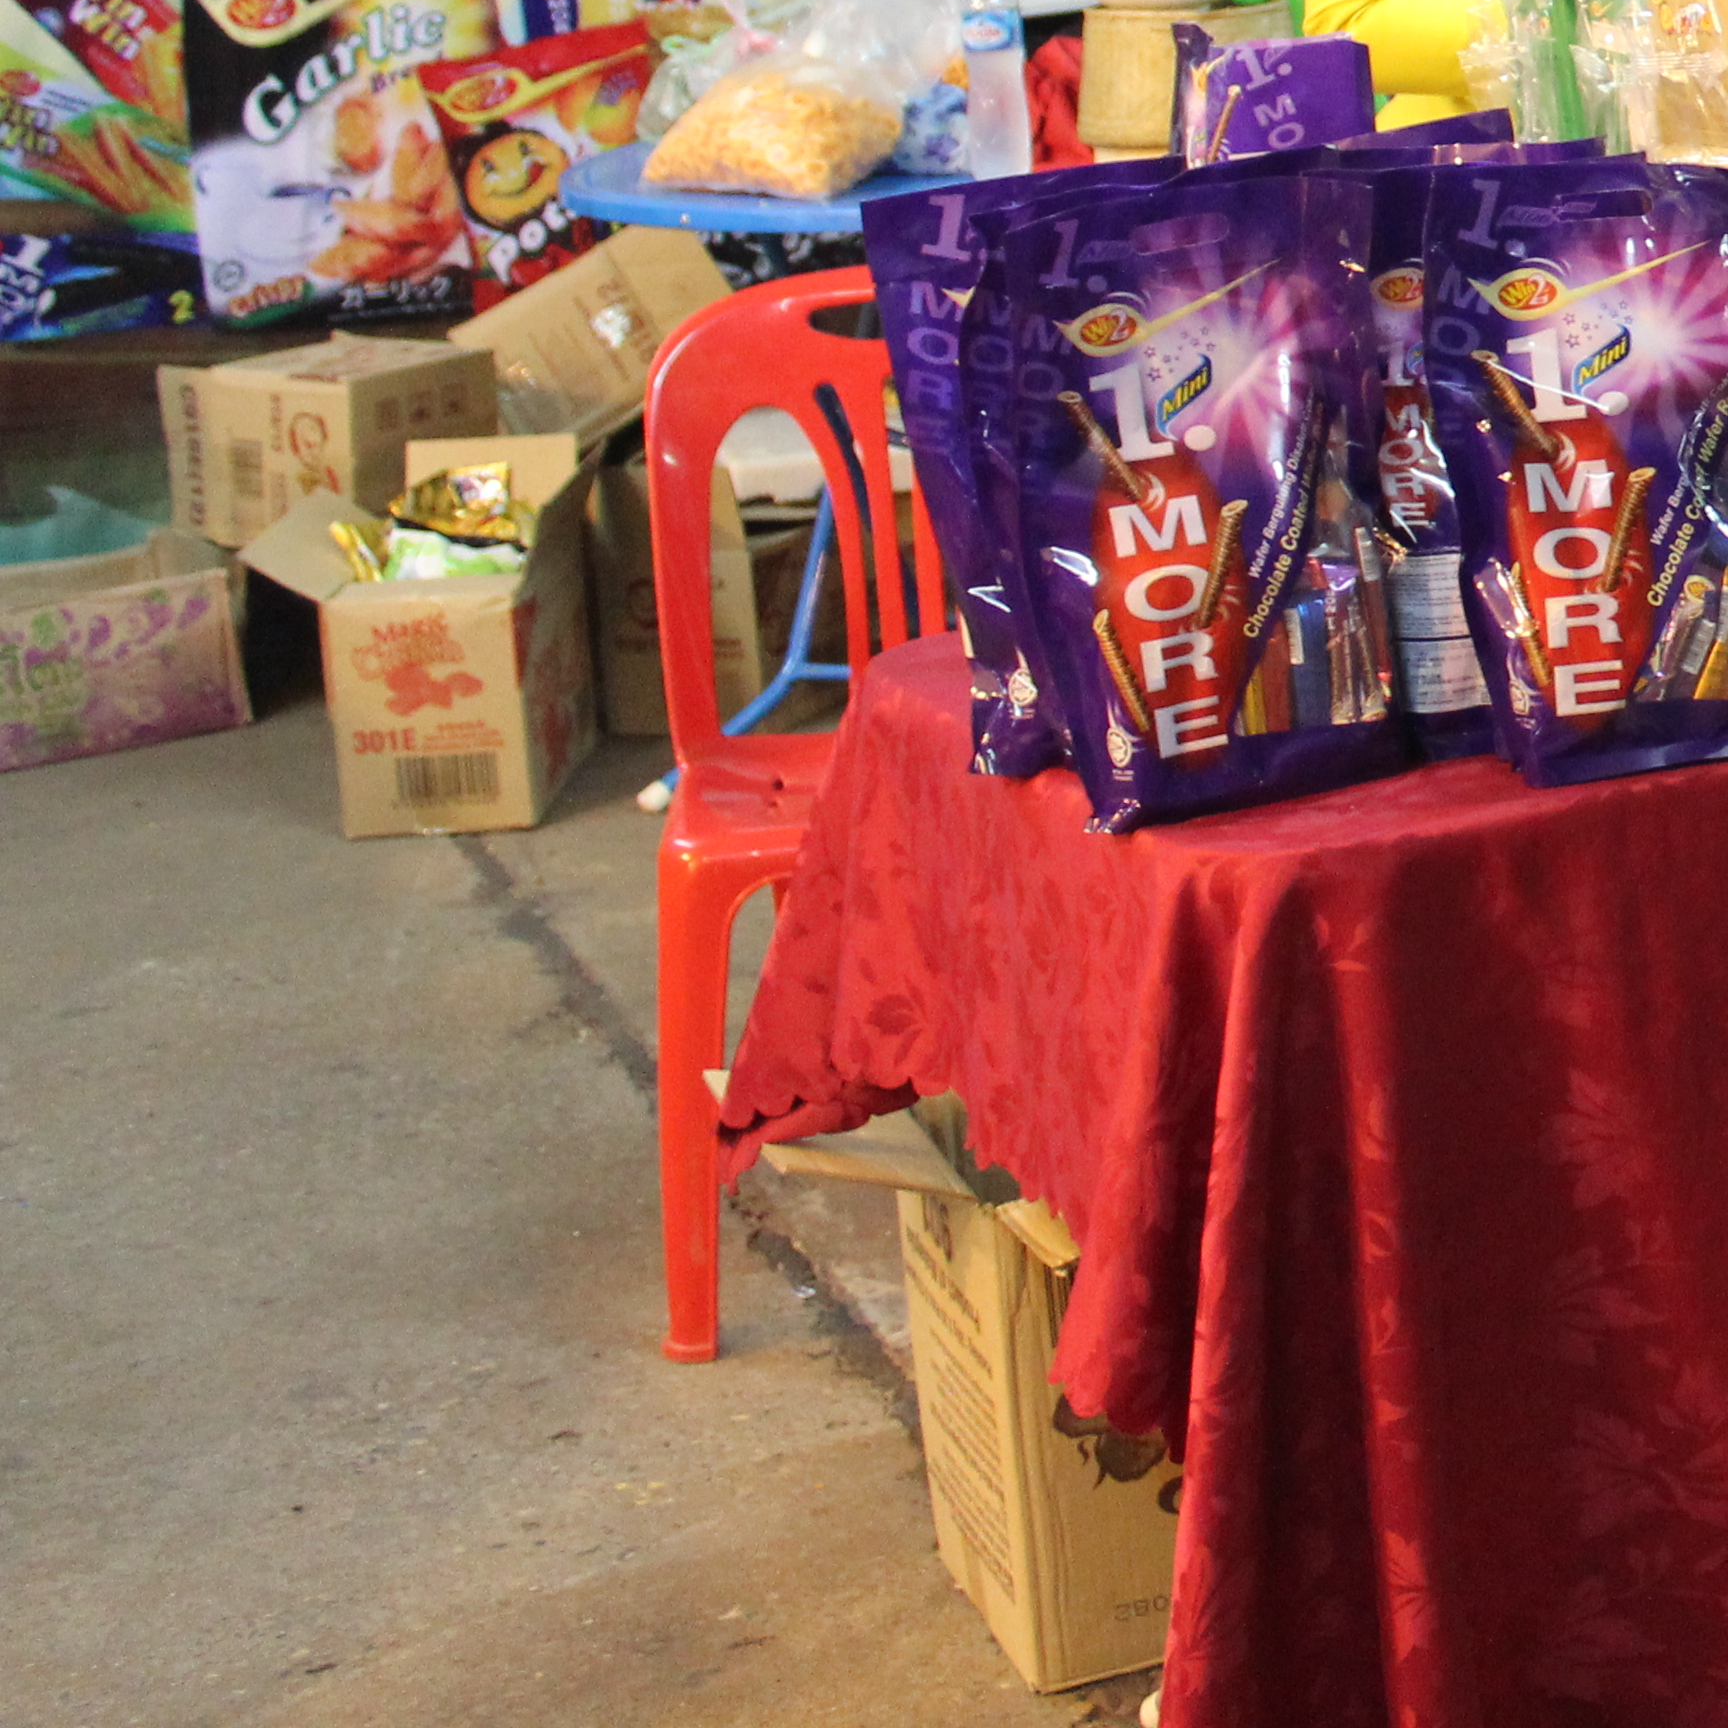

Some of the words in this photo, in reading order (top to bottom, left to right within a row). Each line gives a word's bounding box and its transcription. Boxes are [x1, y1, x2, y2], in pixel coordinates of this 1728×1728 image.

[242, 2, 447, 145] Garlic
[1158, 362, 1213, 424] Mini
[1577, 333, 1630, 389] Mini
[1248, 538, 1272, 580] Wafer
[1646, 521, 1696, 608] Chocolate
[1699, 418, 1725, 465] Wafer
[1108, 494, 1229, 759] MORE
[1242, 551, 1293, 639] Chocolate
[1523, 459, 1627, 718] MORE
